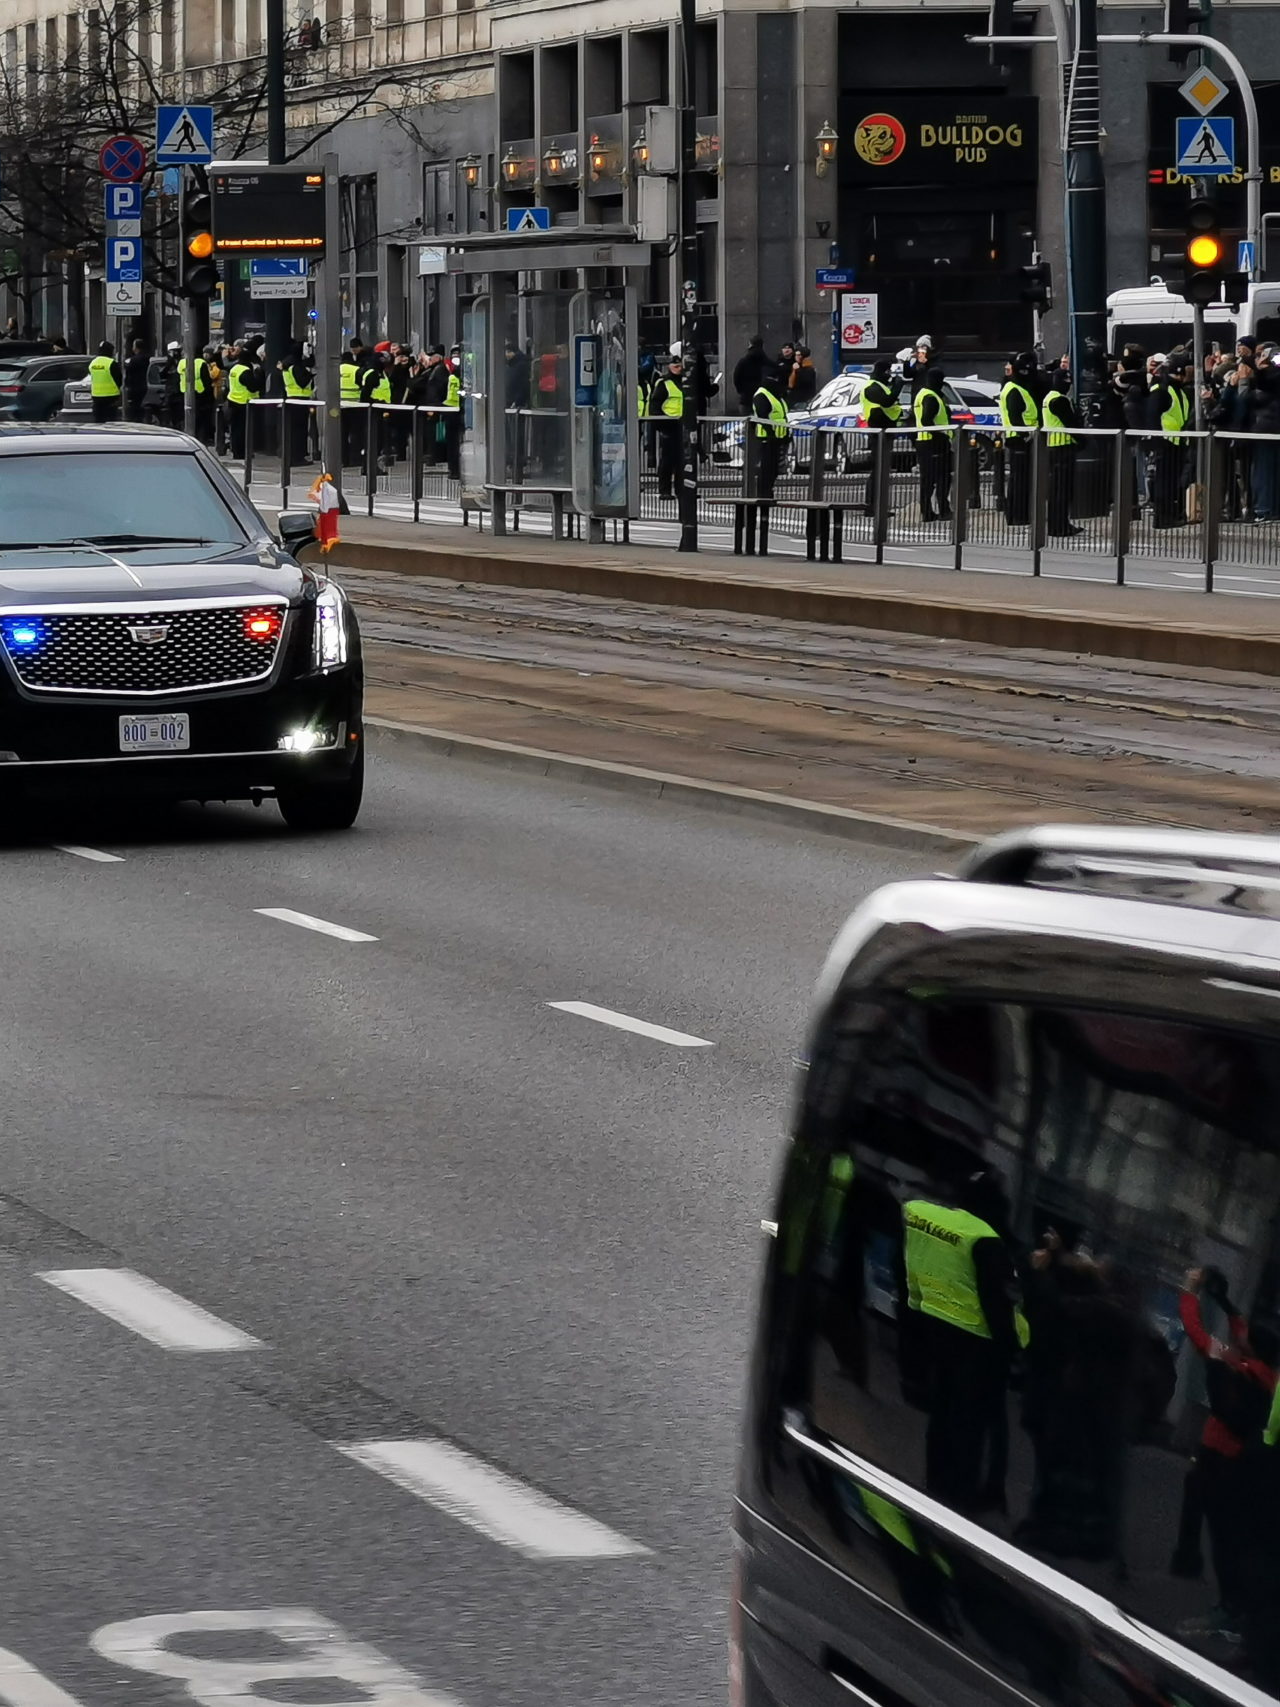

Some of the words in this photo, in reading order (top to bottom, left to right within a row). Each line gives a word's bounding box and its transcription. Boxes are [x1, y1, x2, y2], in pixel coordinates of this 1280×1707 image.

[921, 124, 1022, 147] BULLDOG
[955, 147, 987, 163] PUB
[113, 187, 134, 216] P
[113, 240, 135, 270] P
[124, 724, 146, 741] 800
[161, 722, 184, 740] 002
